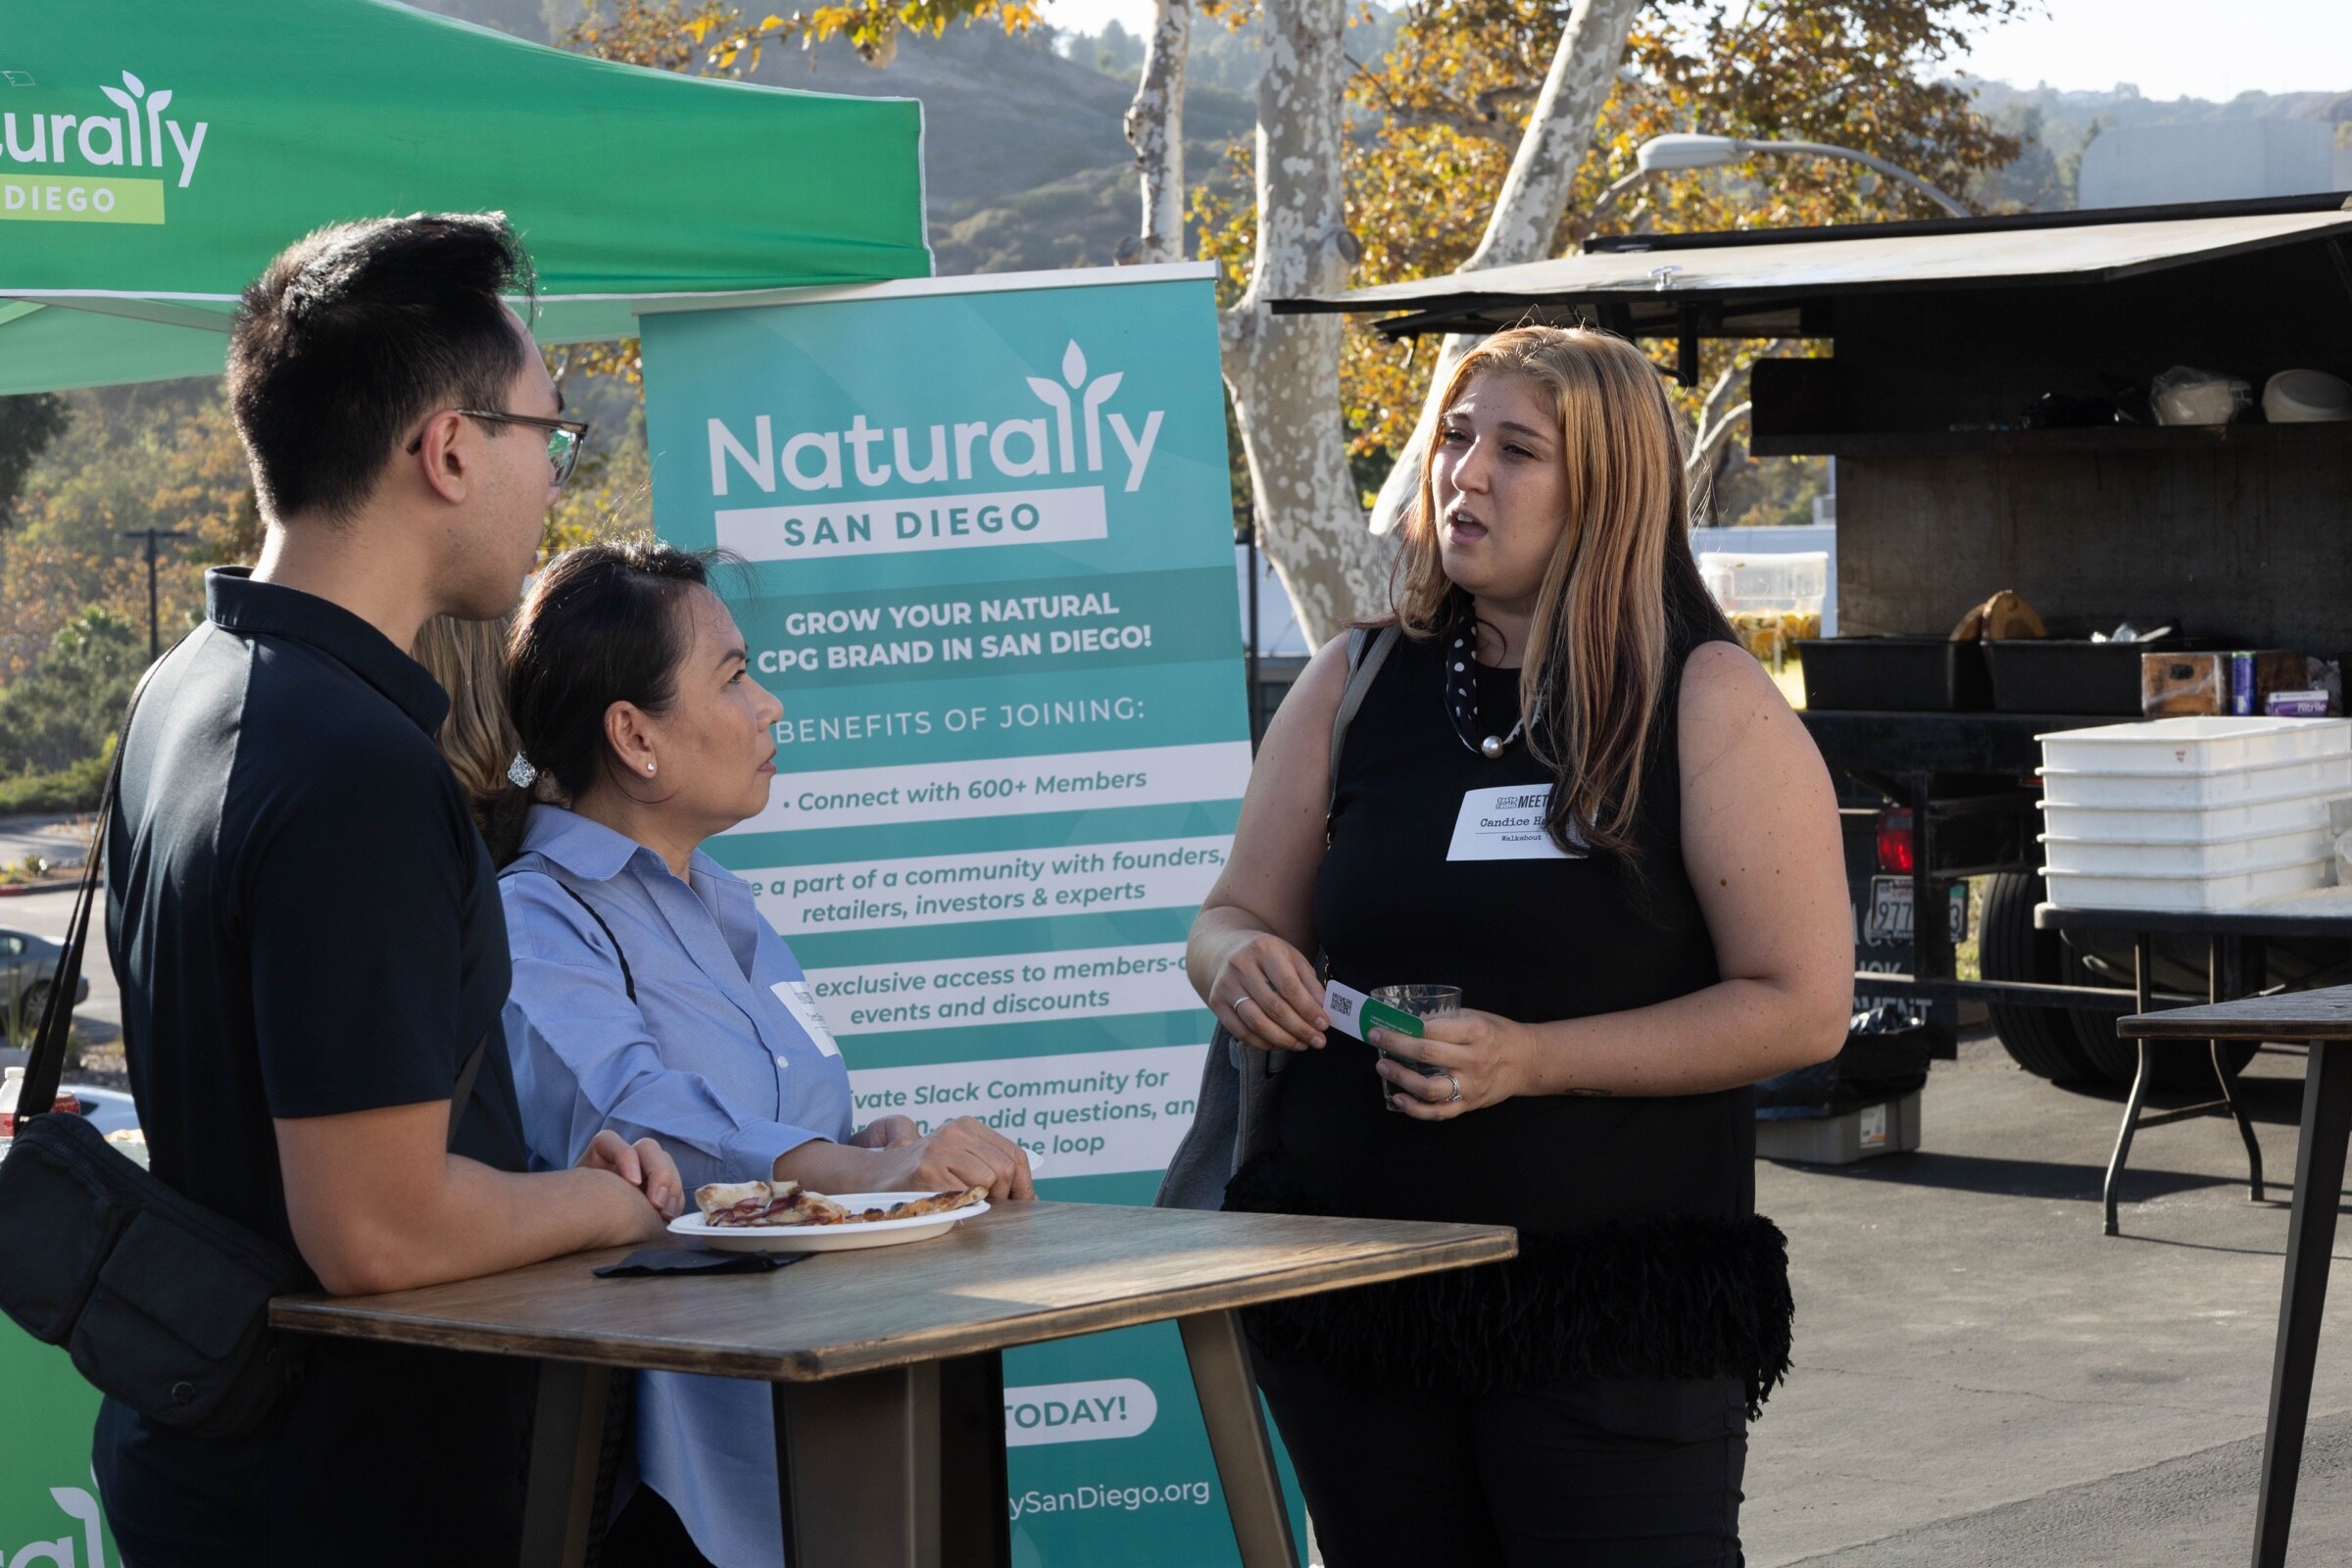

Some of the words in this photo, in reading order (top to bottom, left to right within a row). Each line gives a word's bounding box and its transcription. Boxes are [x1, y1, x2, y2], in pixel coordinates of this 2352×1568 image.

[0, 78, 208, 188] urally
[4, 184, 116, 213] DIEGO
[708, 365, 1165, 496] Naturally
[784, 514, 873, 548] SAN
[895, 503, 1041, 541] DIEGO
[785, 608, 881, 636] GROW
[888, 602, 972, 629] YOUR
[980, 592, 1120, 623] NATURAL
[757, 648, 819, 674] CPG
[826, 640, 934, 669] BRAND
[942, 637, 973, 662] IN
[981, 632, 1042, 660] SAN
[1050, 624, 1152, 654] DIEGO!
[775, 710, 932, 744] BENEFITS
[944, 707, 987, 732] OF
[1000, 697, 1145, 728] JOINING:
[2297, 701, 2328, 713] nitrile
[798, 786, 900, 811] Connect
[906, 782, 960, 804] with
[967, 778, 1027, 800] 600+
[1034, 770, 1148, 795] Members
[1480, 816, 1531, 828] Candice
[752, 880, 763, 897] e
[770, 879, 785, 896] a
[792, 872, 845, 899] part
[852, 868, 878, 890] of
[883, 870, 899, 888] a
[905, 857, 1046, 886] community
[1052, 853, 1105, 876] with
[1112, 846, 1225, 871] founders,
[802, 899, 908, 923] retailers,
[915, 893, 1025, 915] investors
[1032, 887, 1049, 906] &
[1054, 882, 1146, 907] experts
[814, 971, 927, 998] exclusive
[933, 967, 1015, 990] access
[1021, 964, 1047, 983] to
[1053, 956, 1187, 981] members-o
[850, 1002, 931, 1025] events
[937, 996, 986, 1018] and
[992, 989, 1110, 1014] discounts
[850, 1089, 907, 1109] ivate
[913, 1081, 980, 1105] Slack
[987, 1070, 1130, 1100] Community
[1135, 1068, 1170, 1089] for
[1033, 1100, 1157, 1130] questions,
[1164, 1099, 1196, 1116] an
[1016, 1137, 1046, 1155] he
[1052, 1134, 1105, 1156] loop
[1008, 1481, 1210, 1521] ySanDiego.org
